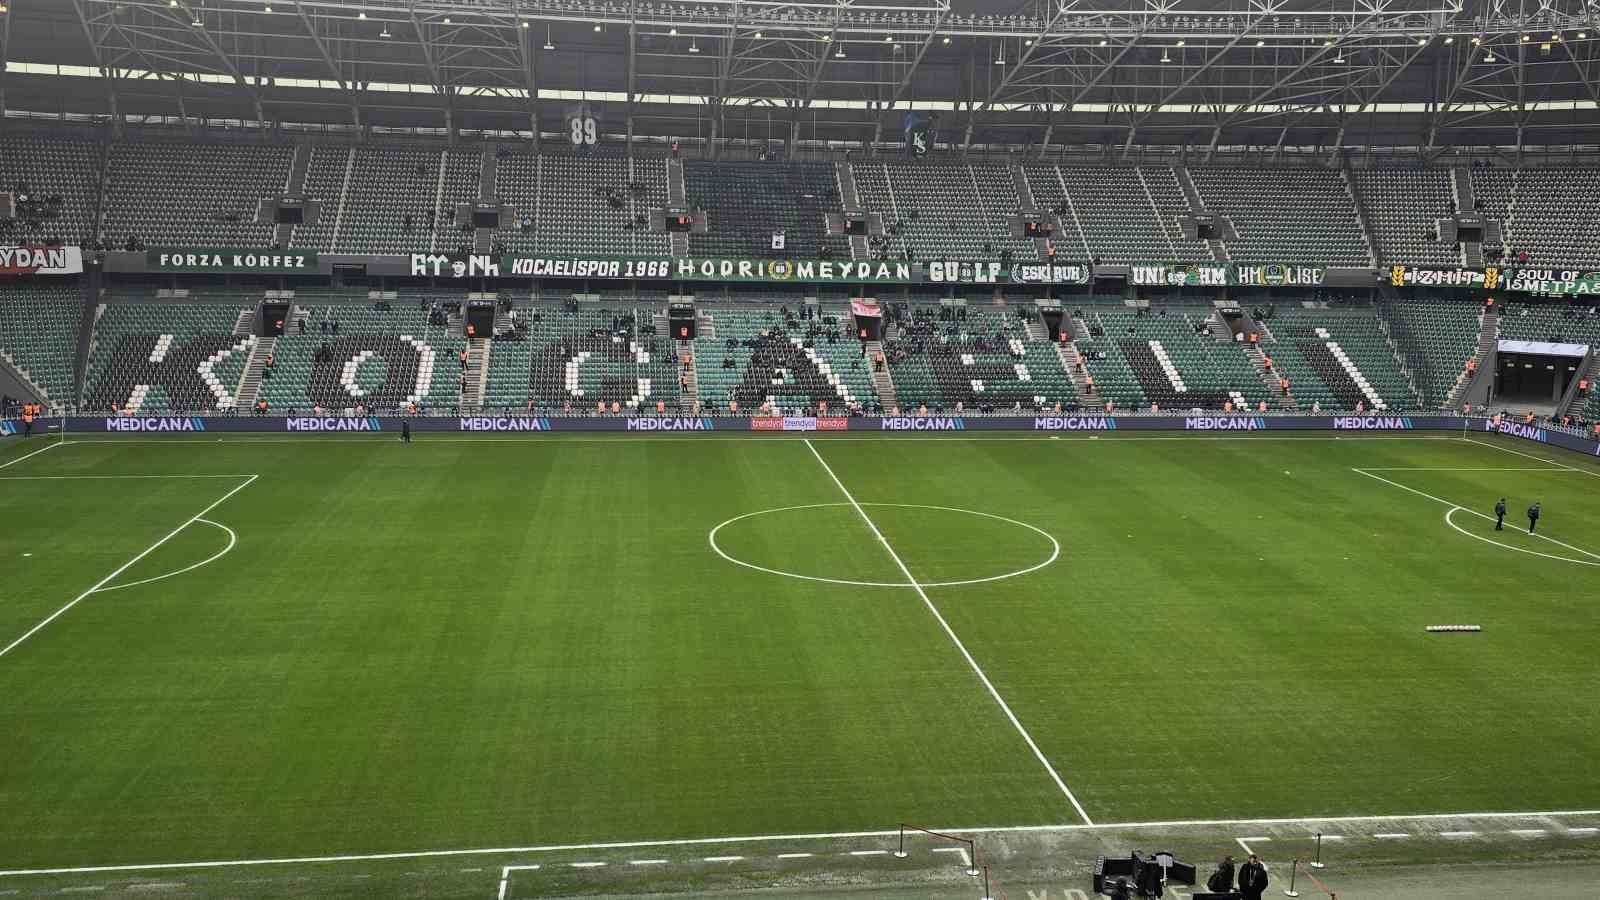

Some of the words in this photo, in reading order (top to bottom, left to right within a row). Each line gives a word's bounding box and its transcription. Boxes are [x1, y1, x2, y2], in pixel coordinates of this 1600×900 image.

[571, 117, 596, 144] 89
[0, 247, 65, 268] YDAN
[160, 254, 223, 266] FORZA
[624, 261, 670, 277] 1966
[678, 259, 764, 280] HODRI
[796, 261, 910, 280] MEYDAN
[1516, 264, 1556, 281] SOUL
[1561, 270, 1580, 282] OF
[1199, 267, 1226, 285] HM
[107, 418, 192, 430] MEDICANA
[287, 418, 370, 430] MEDICANA
[460, 418, 541, 430] MEDICANA
[627, 418, 705, 430] MEDICANA
[752, 418, 783, 429] trendyol
[784, 418, 816, 429] trendyol
[817, 418, 848, 429] trendyol
[882, 418, 955, 430] MEDICANA
[1035, 418, 1107, 429] MEDICANA
[1185, 418, 1257, 429] MEDICANA
[1334, 418, 1404, 429] MEDICANA
